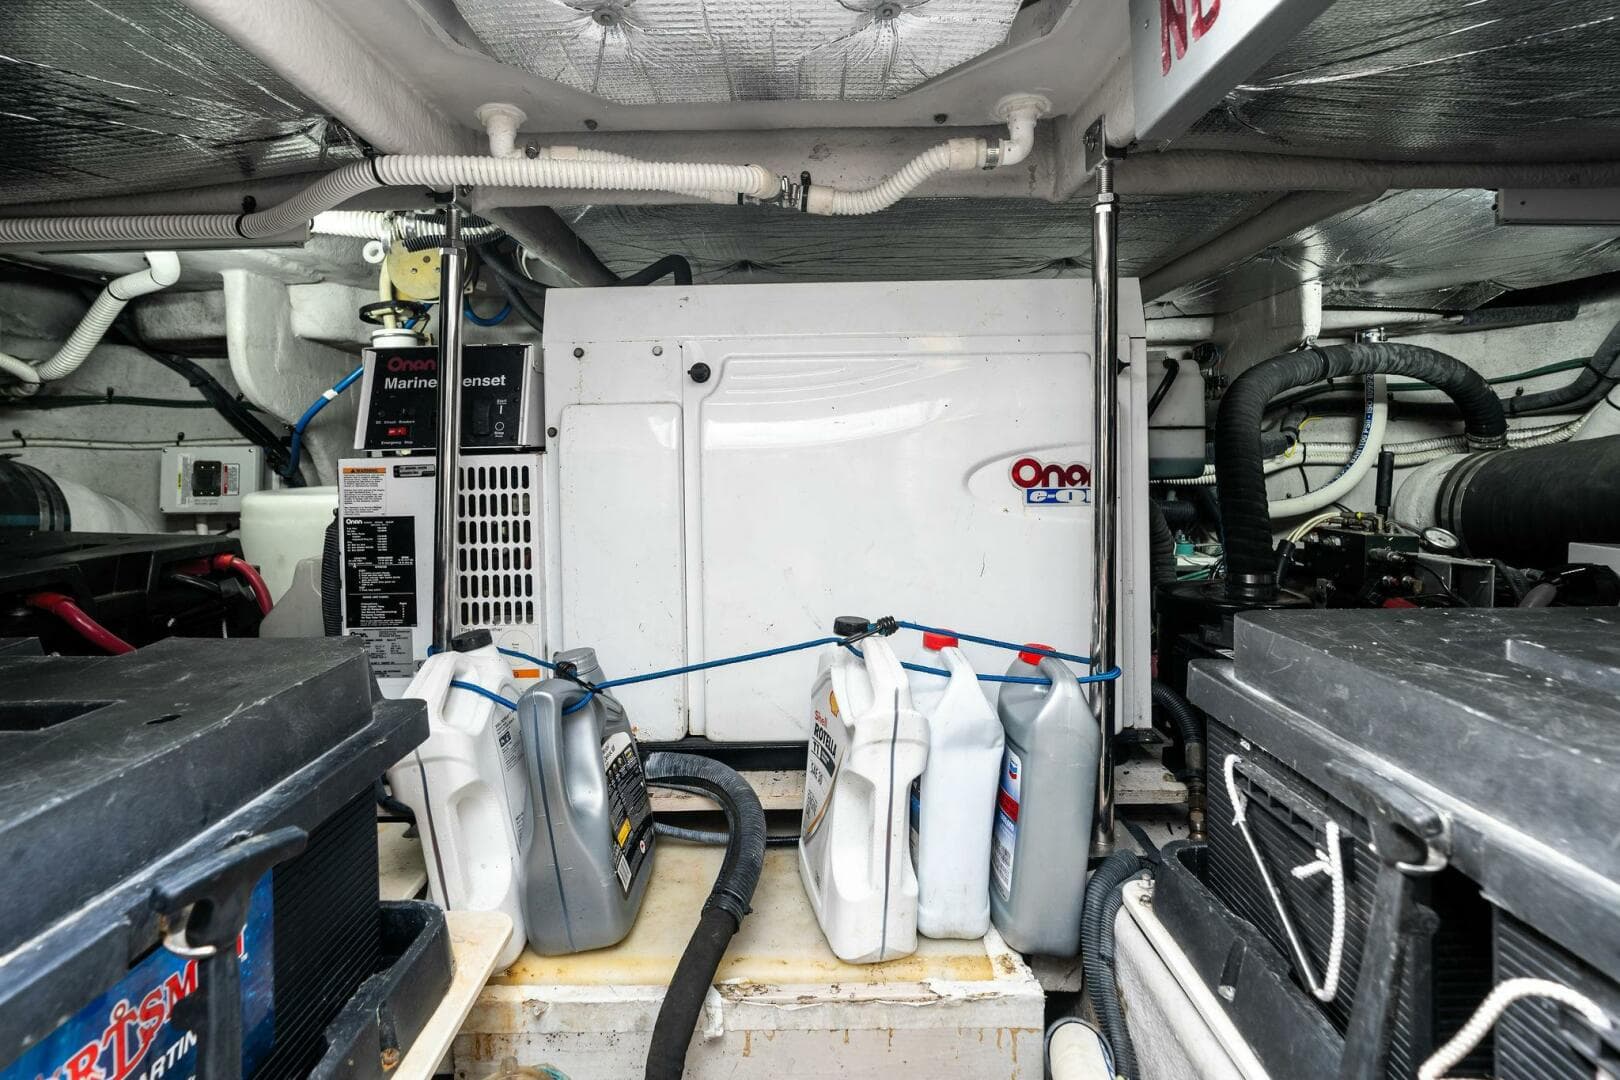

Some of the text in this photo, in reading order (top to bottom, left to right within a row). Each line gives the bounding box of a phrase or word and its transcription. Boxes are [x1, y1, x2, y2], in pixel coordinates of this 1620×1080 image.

[387, 356, 436, 372] Onan
[384, 374, 507, 390] Marine enset
[1012, 458, 1091, 488] Ona
[815, 709, 828, 728] Shell
[813, 723, 837, 759] ROTELLA
